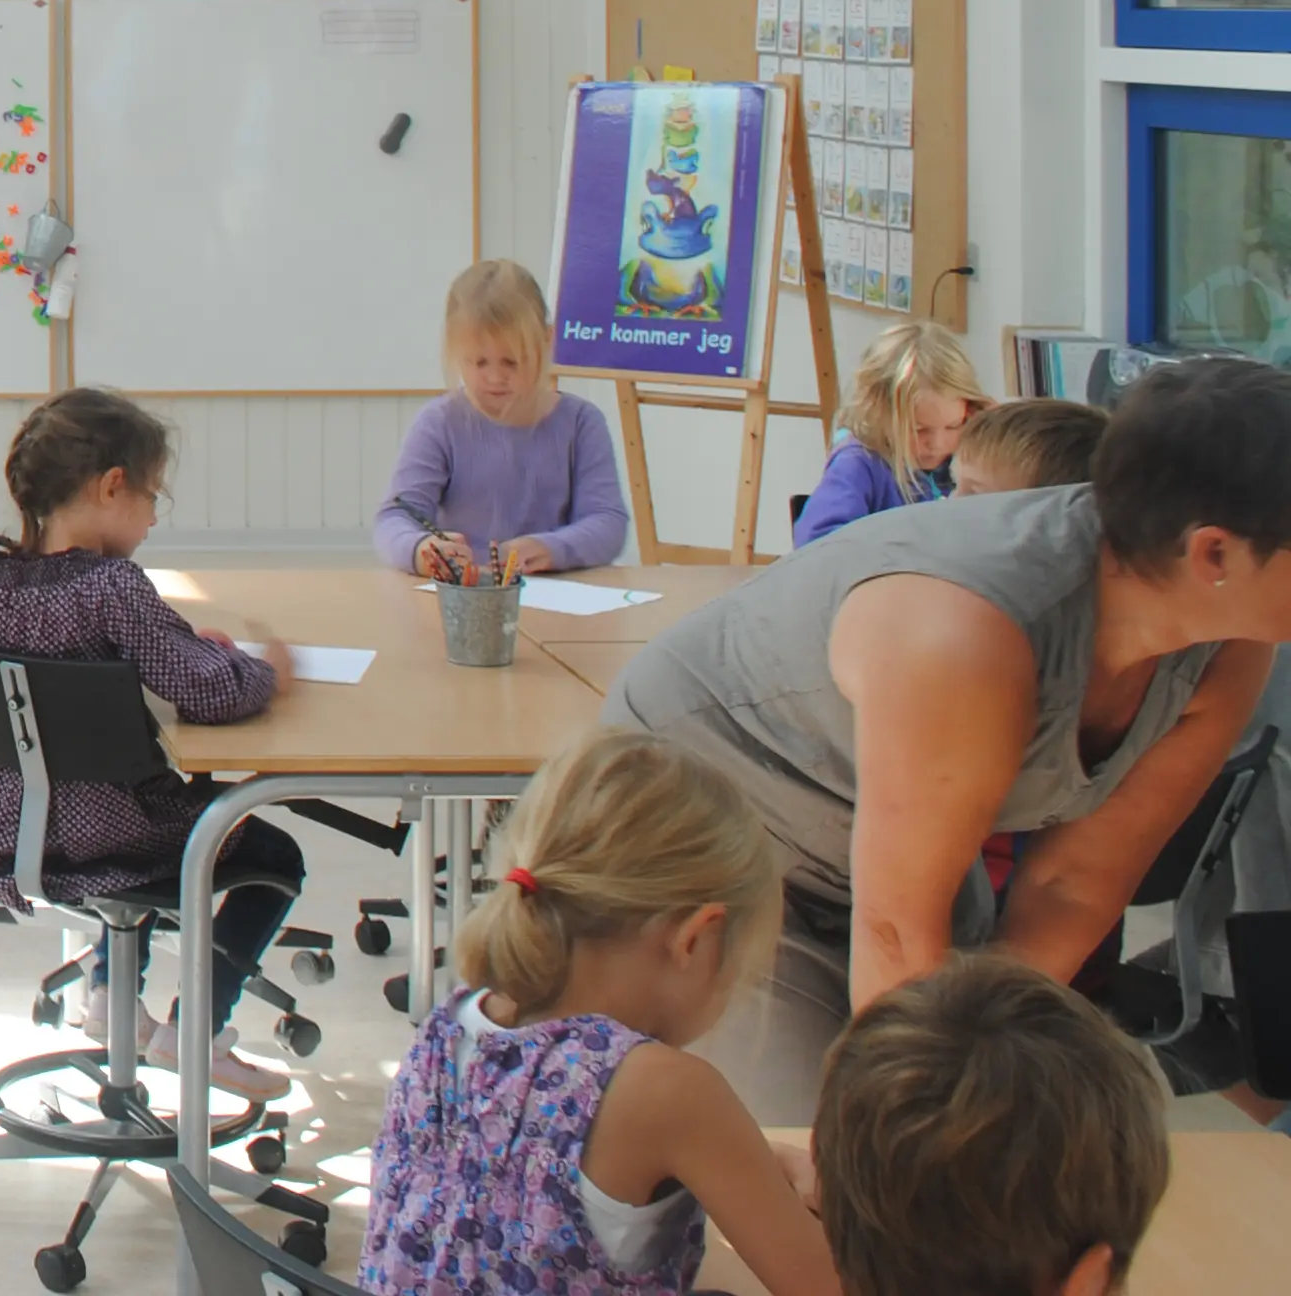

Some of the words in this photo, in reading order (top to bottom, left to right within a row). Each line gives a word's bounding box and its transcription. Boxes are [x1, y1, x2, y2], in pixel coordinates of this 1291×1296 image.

[563, 319, 603, 341] Her
[610, 322, 691, 346] kommer
[697, 328, 733, 354] jeg
